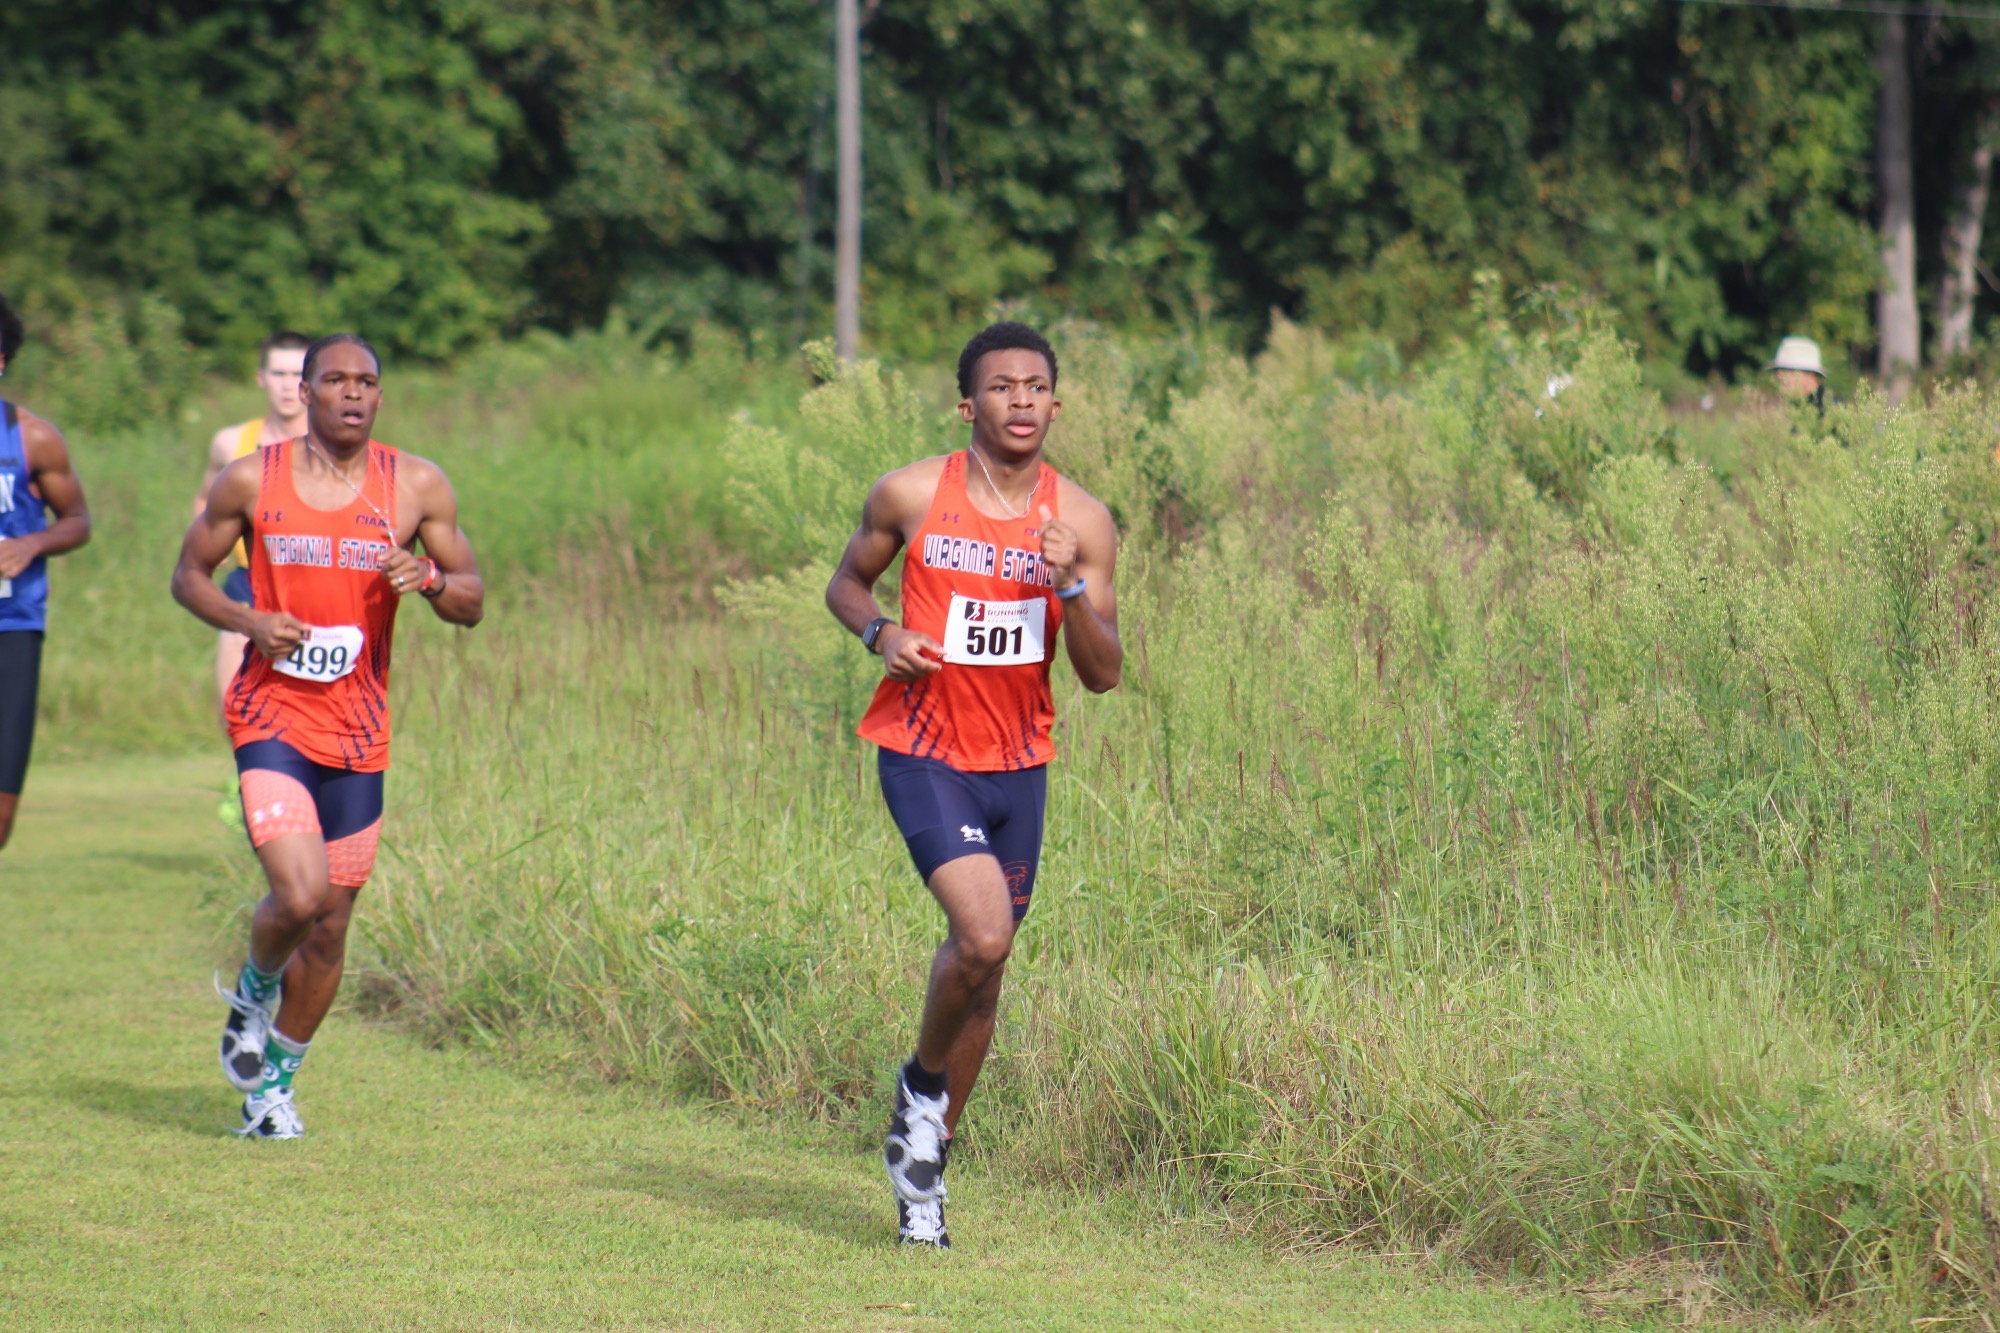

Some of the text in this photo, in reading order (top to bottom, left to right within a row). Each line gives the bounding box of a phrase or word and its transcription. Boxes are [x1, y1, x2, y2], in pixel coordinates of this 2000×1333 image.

[262, 534, 332, 567] VIRGINIA
[924, 534, 995, 576] VIRGINIA
[987, 607, 1029, 616] RUNNING
[966, 625, 1023, 656] 501
[286, 643, 348, 675] 499
